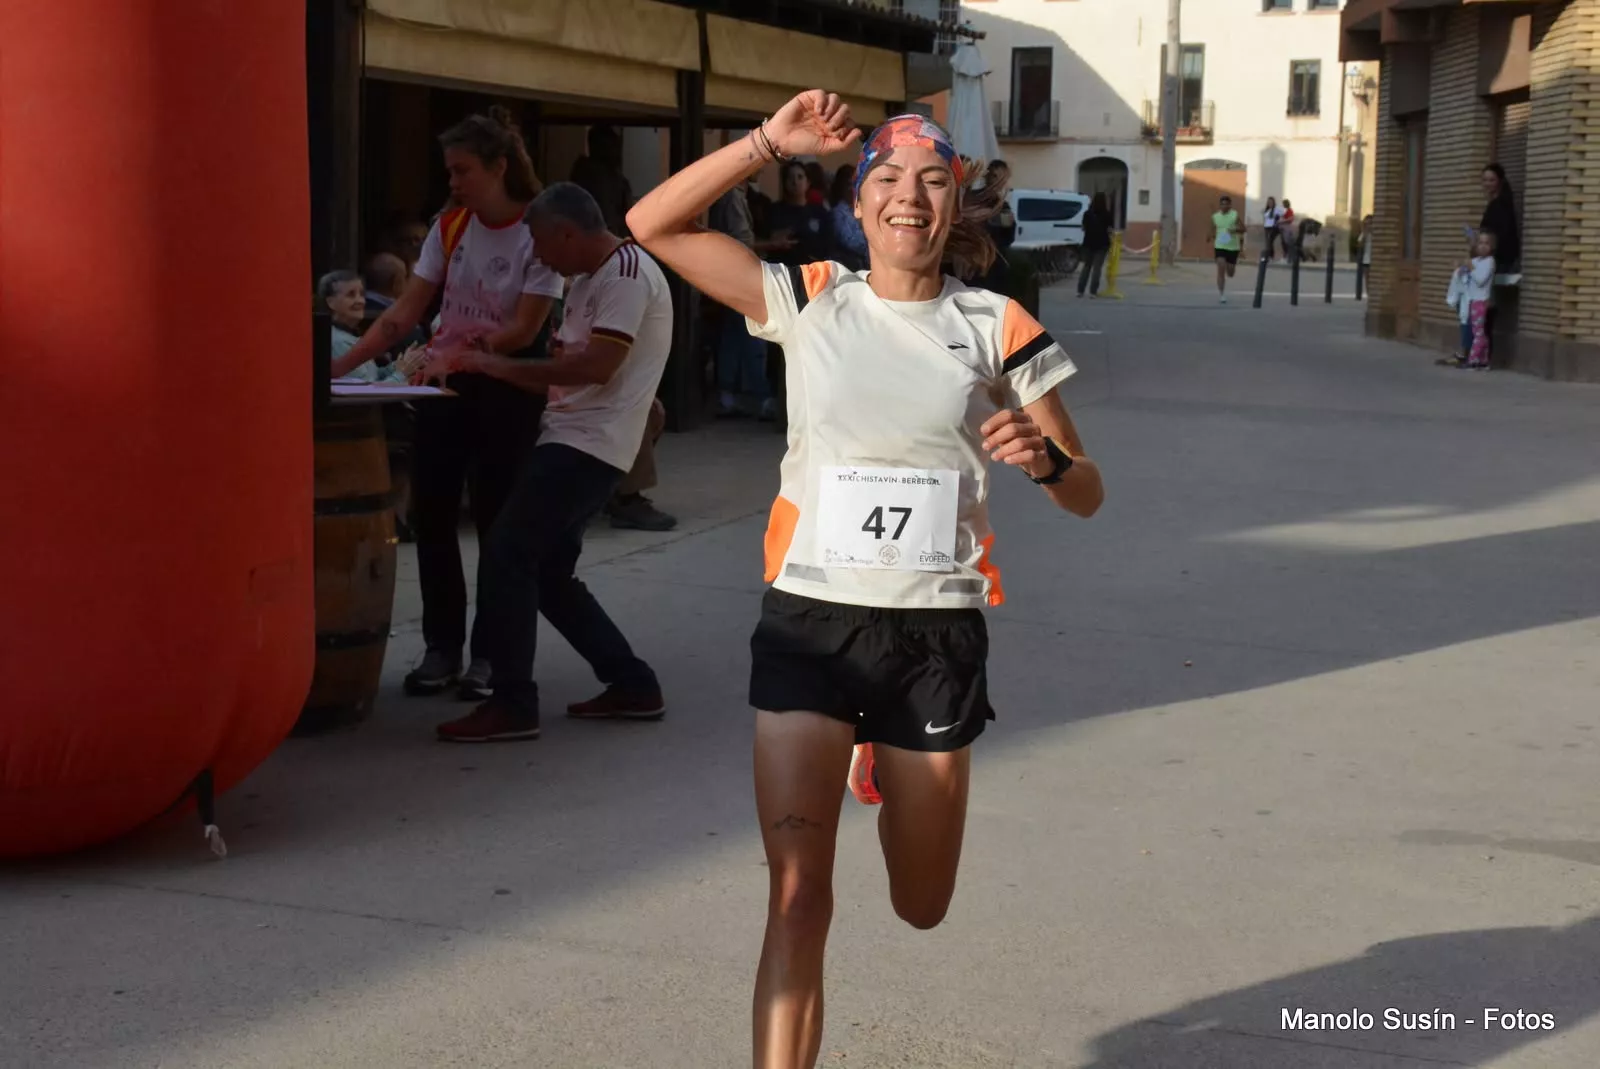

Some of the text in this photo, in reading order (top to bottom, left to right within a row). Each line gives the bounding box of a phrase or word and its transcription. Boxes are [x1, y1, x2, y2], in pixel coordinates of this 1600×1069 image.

[901, 476, 941, 486] BERBEGAL
[862, 506, 912, 540] 47
[919, 554, 951, 563] EVOFEED
